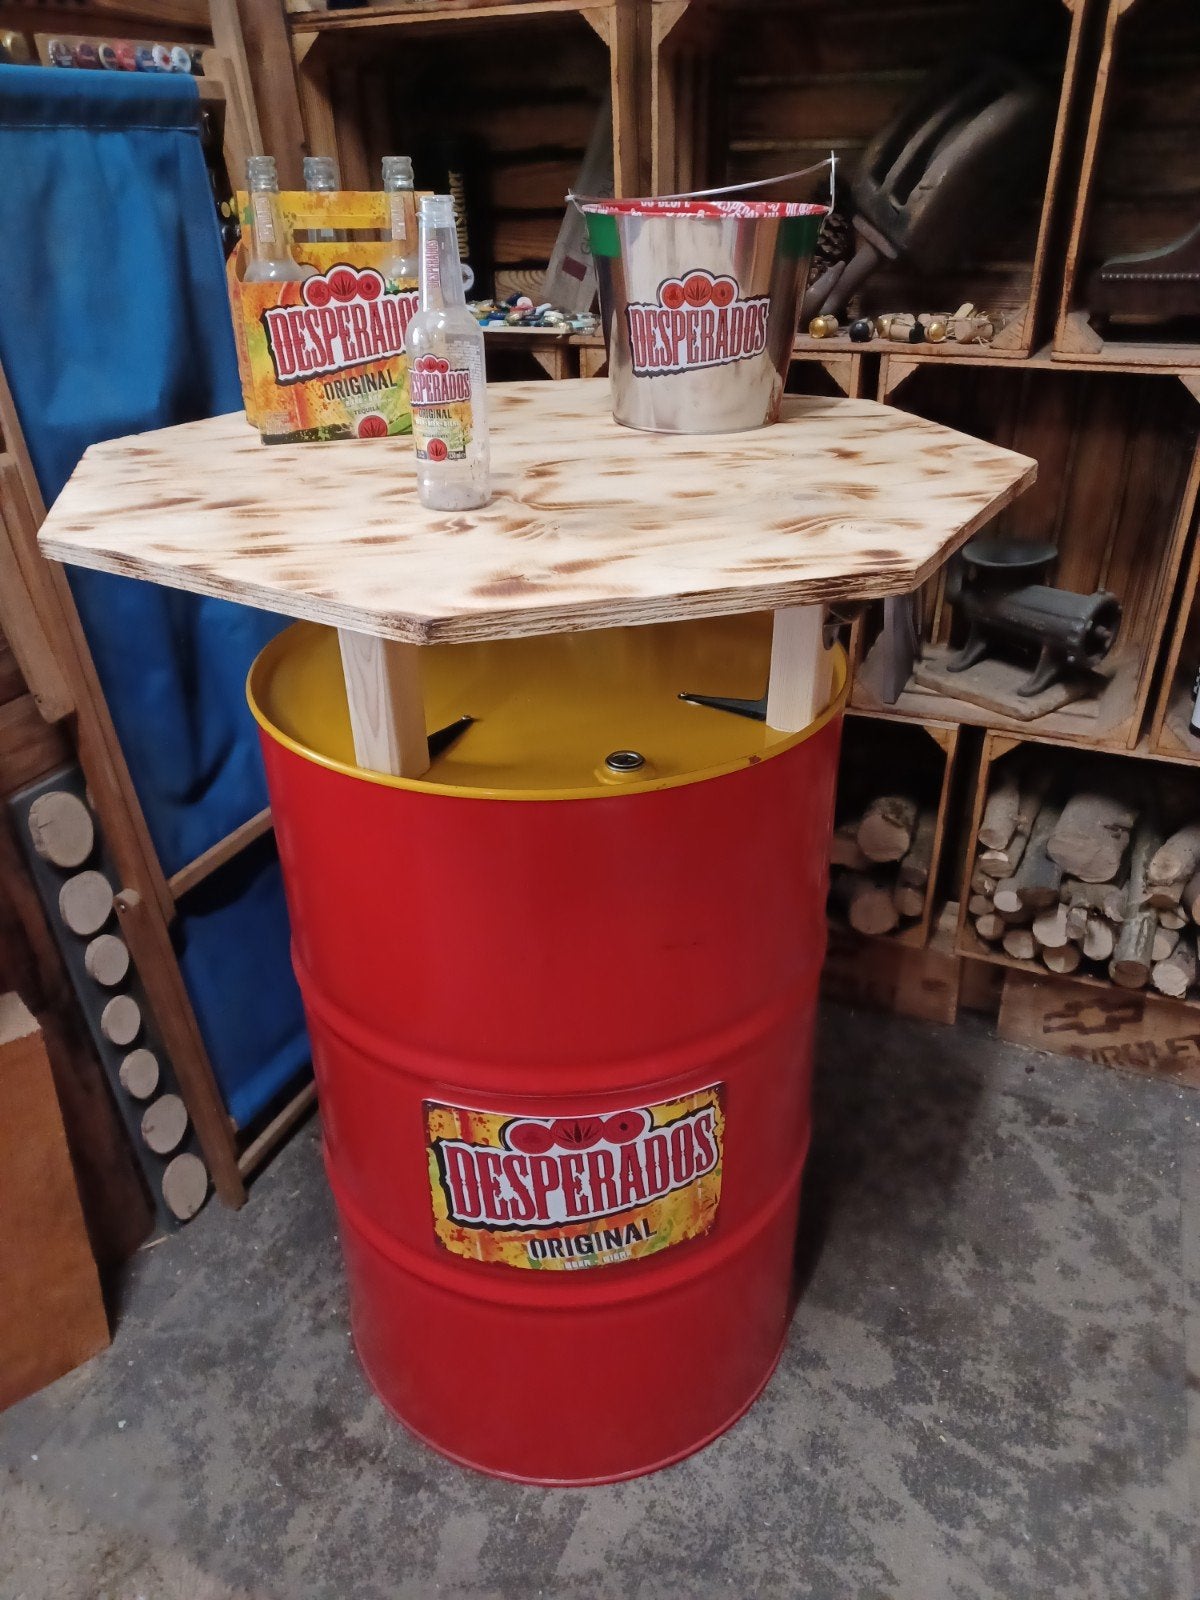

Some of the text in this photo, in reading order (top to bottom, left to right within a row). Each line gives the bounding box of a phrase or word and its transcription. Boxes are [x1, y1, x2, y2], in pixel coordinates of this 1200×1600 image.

[269, 296, 418, 375] DESPERADO
[631, 302, 768, 368] DESPERADOS
[323, 369, 398, 400] ORIGINAL
[354, 406, 380, 415] TEQUILA
[419, 408, 452, 419] ORIGINAL
[444, 1113, 715, 1221] DESPERADOS
[529, 1218, 658, 1259] ORIGINAL
